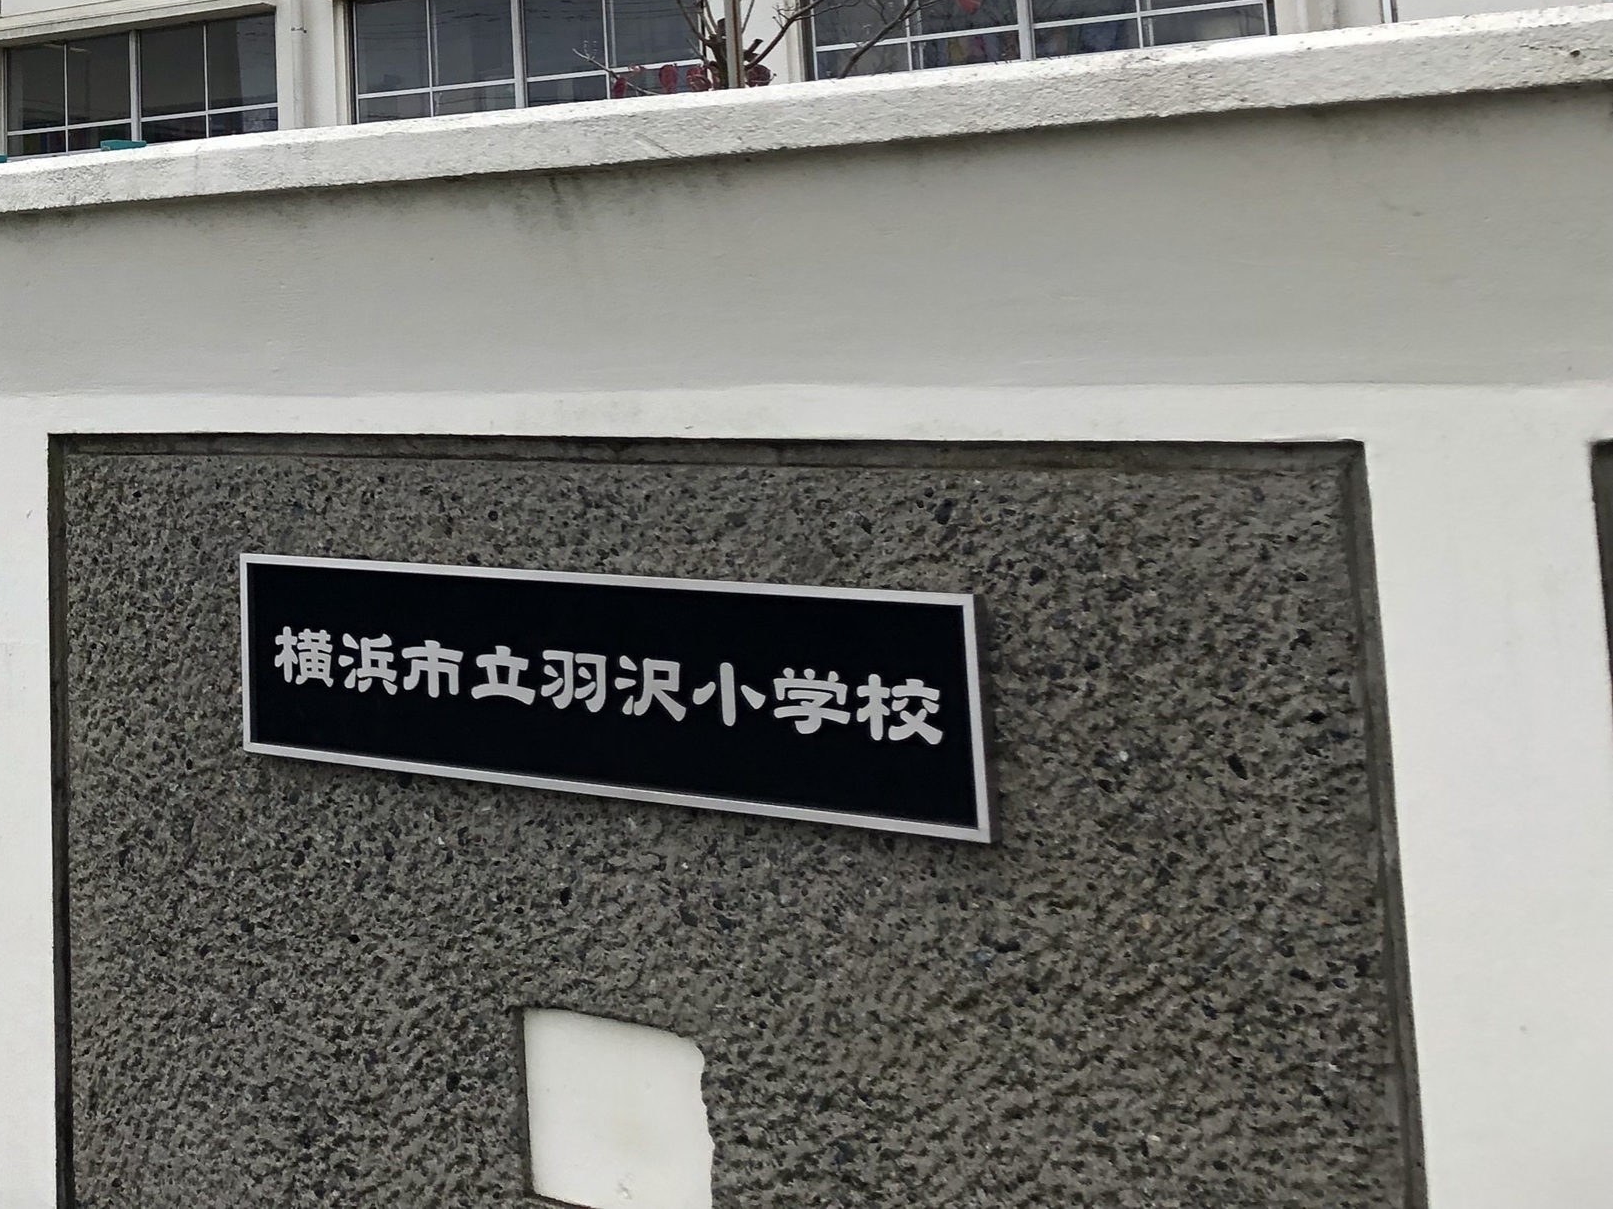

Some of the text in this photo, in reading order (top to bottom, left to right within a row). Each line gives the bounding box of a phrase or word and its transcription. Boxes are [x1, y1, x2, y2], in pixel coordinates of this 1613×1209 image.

[274, 625, 944, 746] 横浜市立羽沢小学校
